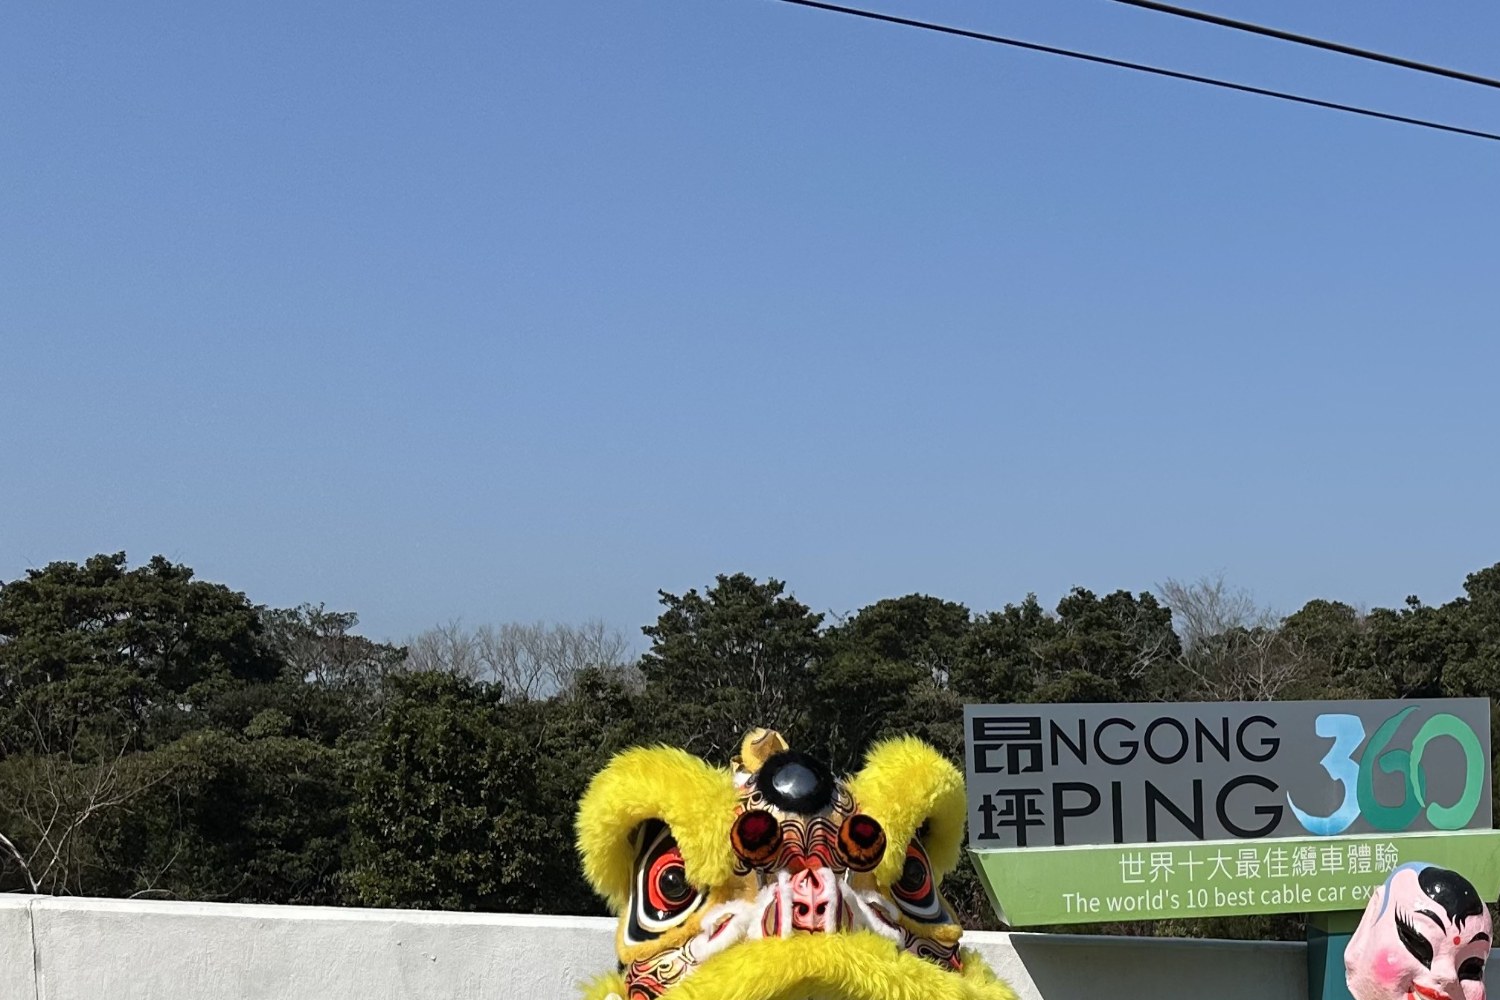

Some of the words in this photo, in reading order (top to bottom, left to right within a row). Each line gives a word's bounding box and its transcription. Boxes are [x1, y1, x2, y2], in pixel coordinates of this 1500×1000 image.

[1050, 716, 1281, 766] NGONG
[1286, 705, 1485, 836] 360
[1052, 774, 1284, 845] PING
[1118, 842, 1399, 884] 世界十大最佳纜車體驗
[1062, 892, 1100, 913] The
[1106, 889, 1180, 912] world's
[1186, 888, 1208, 909] 10
[1214, 886, 1256, 907] best
[1260, 883, 1312, 905] cable
[1317, 886, 1347, 902] car
